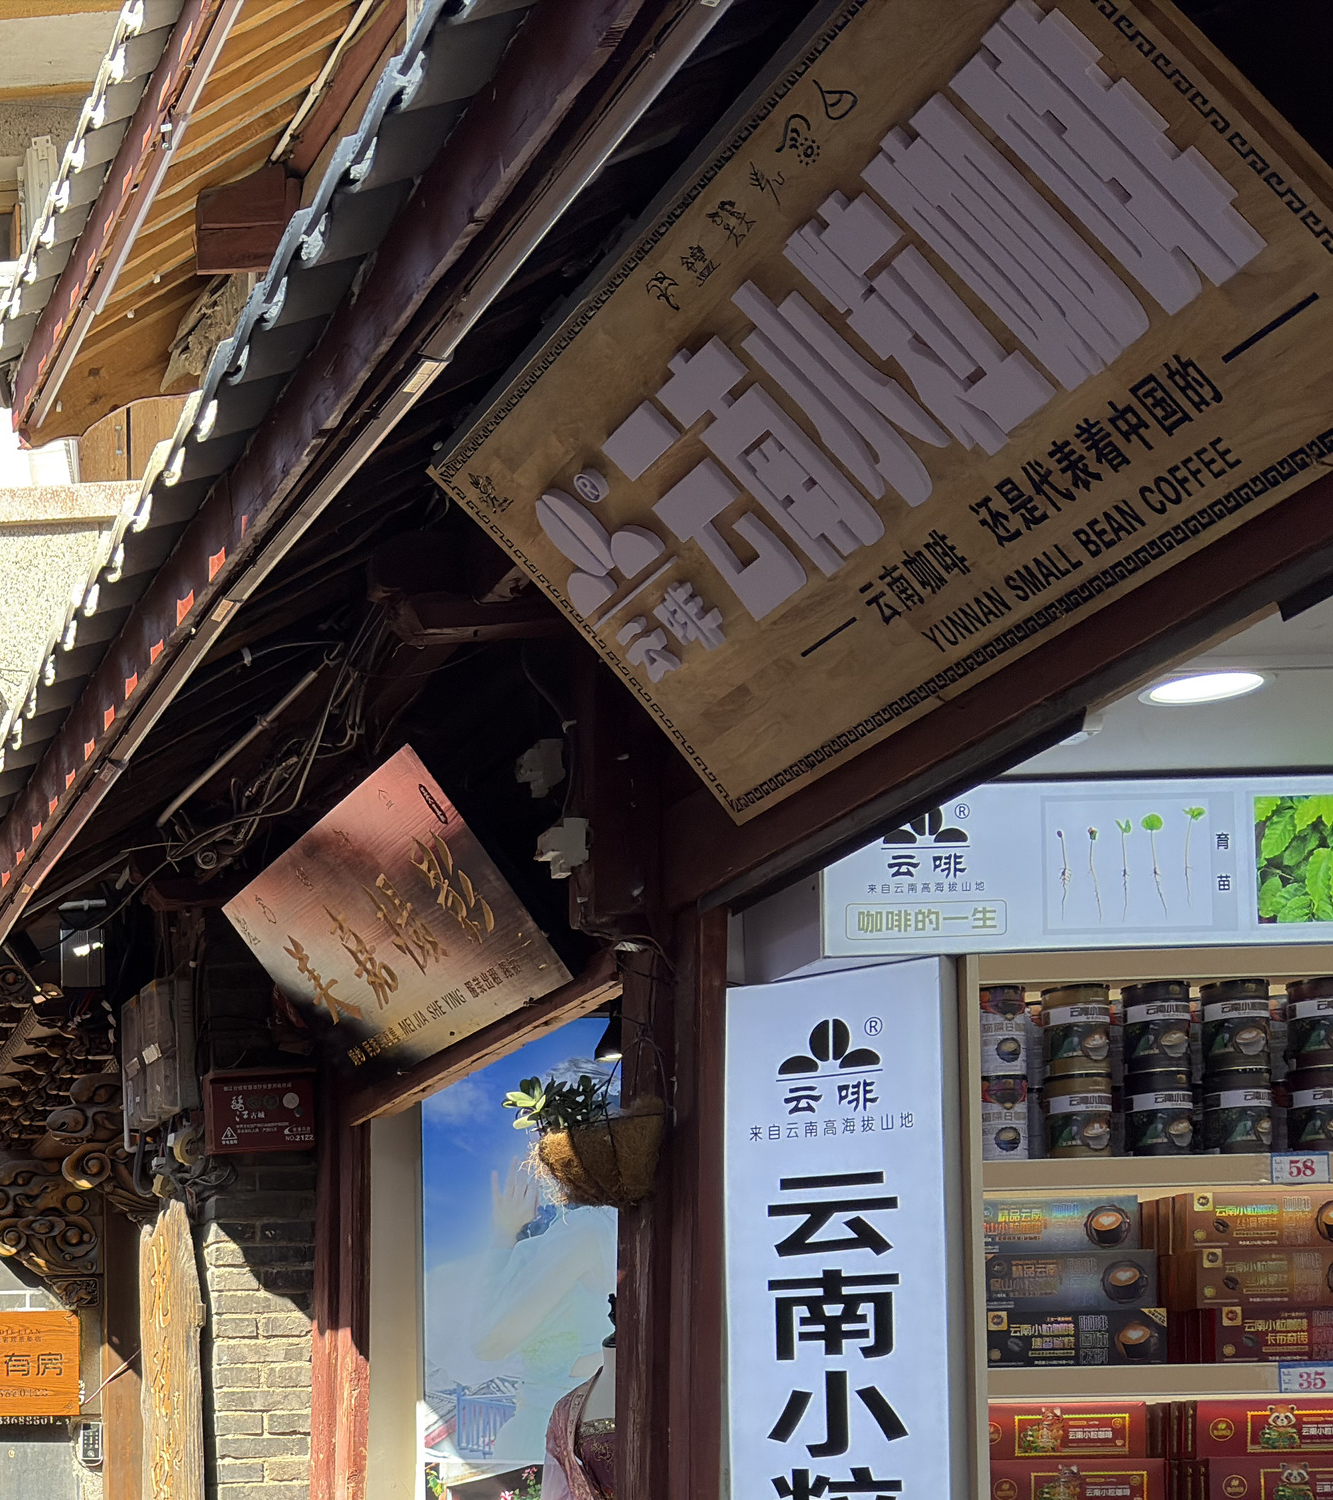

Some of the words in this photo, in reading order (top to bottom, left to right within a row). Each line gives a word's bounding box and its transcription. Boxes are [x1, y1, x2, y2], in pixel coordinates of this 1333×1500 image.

[601, 3, 1268, 622] 云南小粒咖啡
[859, 529, 971, 626] 云南咖啡
[968, 354, 1224, 549] 还是代表着中国的
[923, 586, 1011, 654] YUNNAN
[1010, 543, 1084, 602] SMALL
[1073, 500, 1144, 558] BEAN
[1138, 437, 1243, 516] COFFEE
[616, 582, 727, 684] 云啡
[887, 852, 968, 880] 云啡
[1215, 831, 1232, 893] 育苗
[867, 879, 986, 895] 来自云南高海拔山地
[856, 905, 999, 935] 咖啡的一生
[426, 999, 447, 1021] SHE
[441, 988, 468, 1011] YING
[783, 1078, 882, 1116] 云啡
[749, 1111, 915, 1144] 来自云南高海拔山地
[1288, 1158, 1317, 1180] 58
[1297, 1370, 1327, 1390] 35
